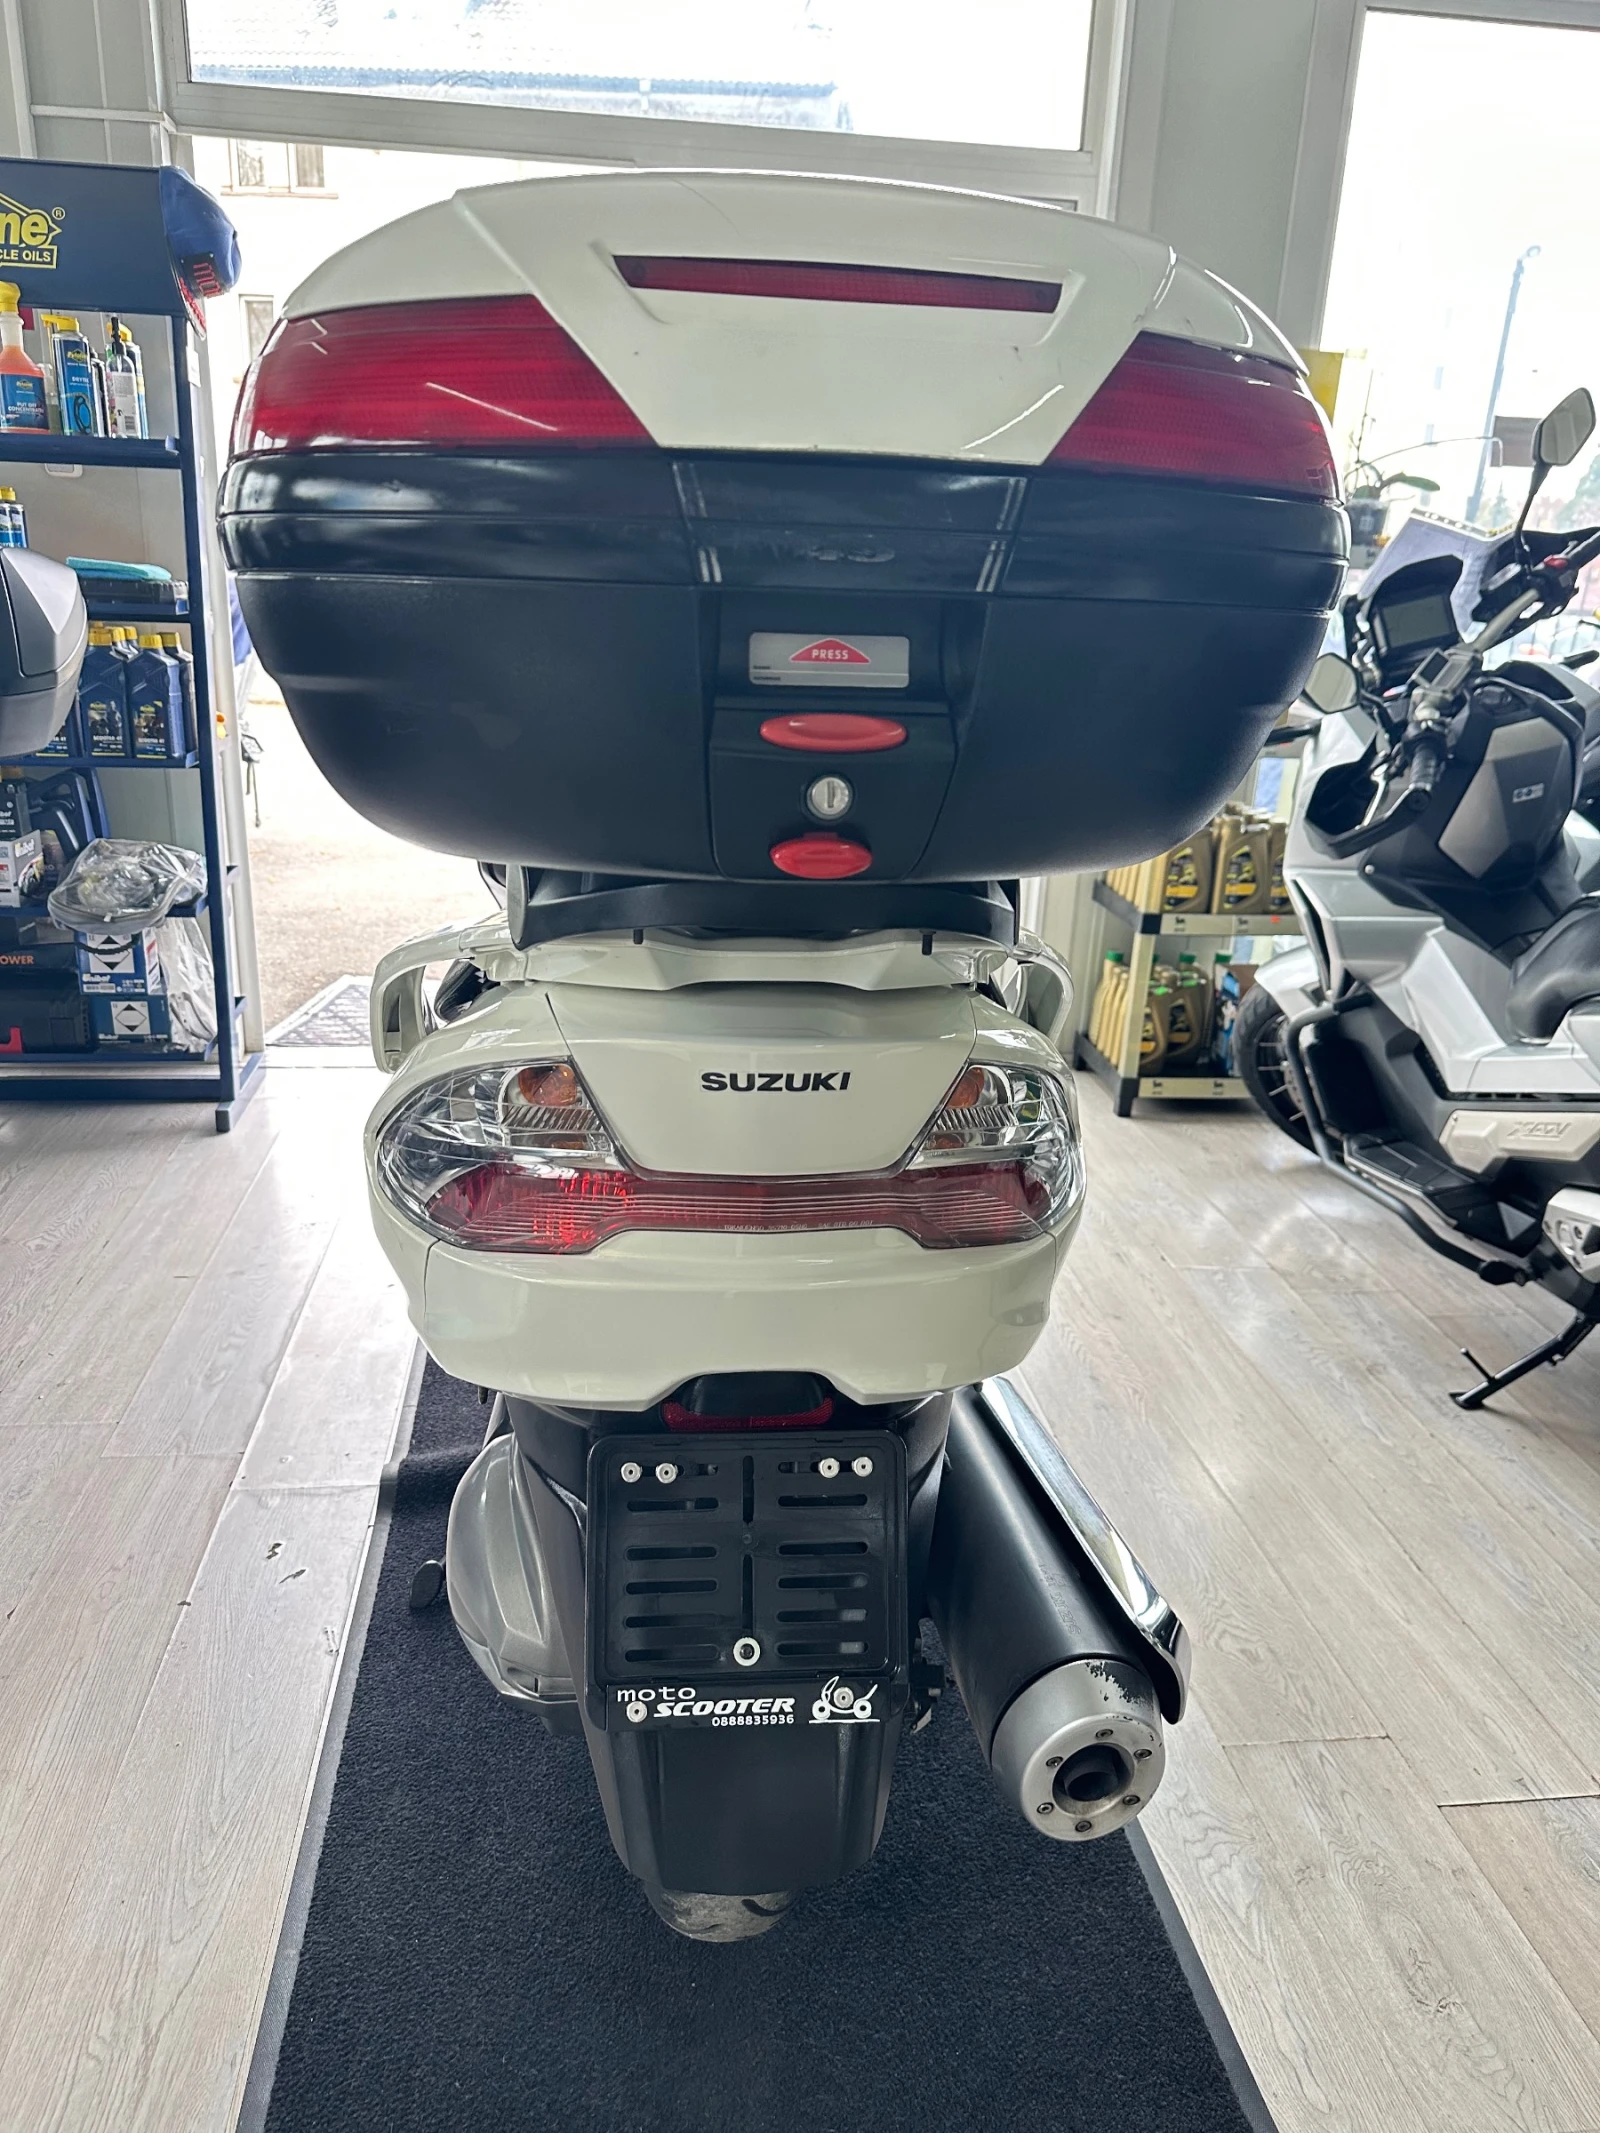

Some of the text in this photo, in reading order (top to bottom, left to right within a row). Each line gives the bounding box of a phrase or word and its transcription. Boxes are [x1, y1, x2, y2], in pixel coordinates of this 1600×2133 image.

[22, 250, 51, 262] OILS
[812, 649, 849, 660] PRESS
[701, 1072, 851, 1092] SUZUKI
[617, 1686, 696, 1702] moto
[653, 1697, 795, 1717] SCOOTER
[712, 1714, 795, 1727] 0888835936
